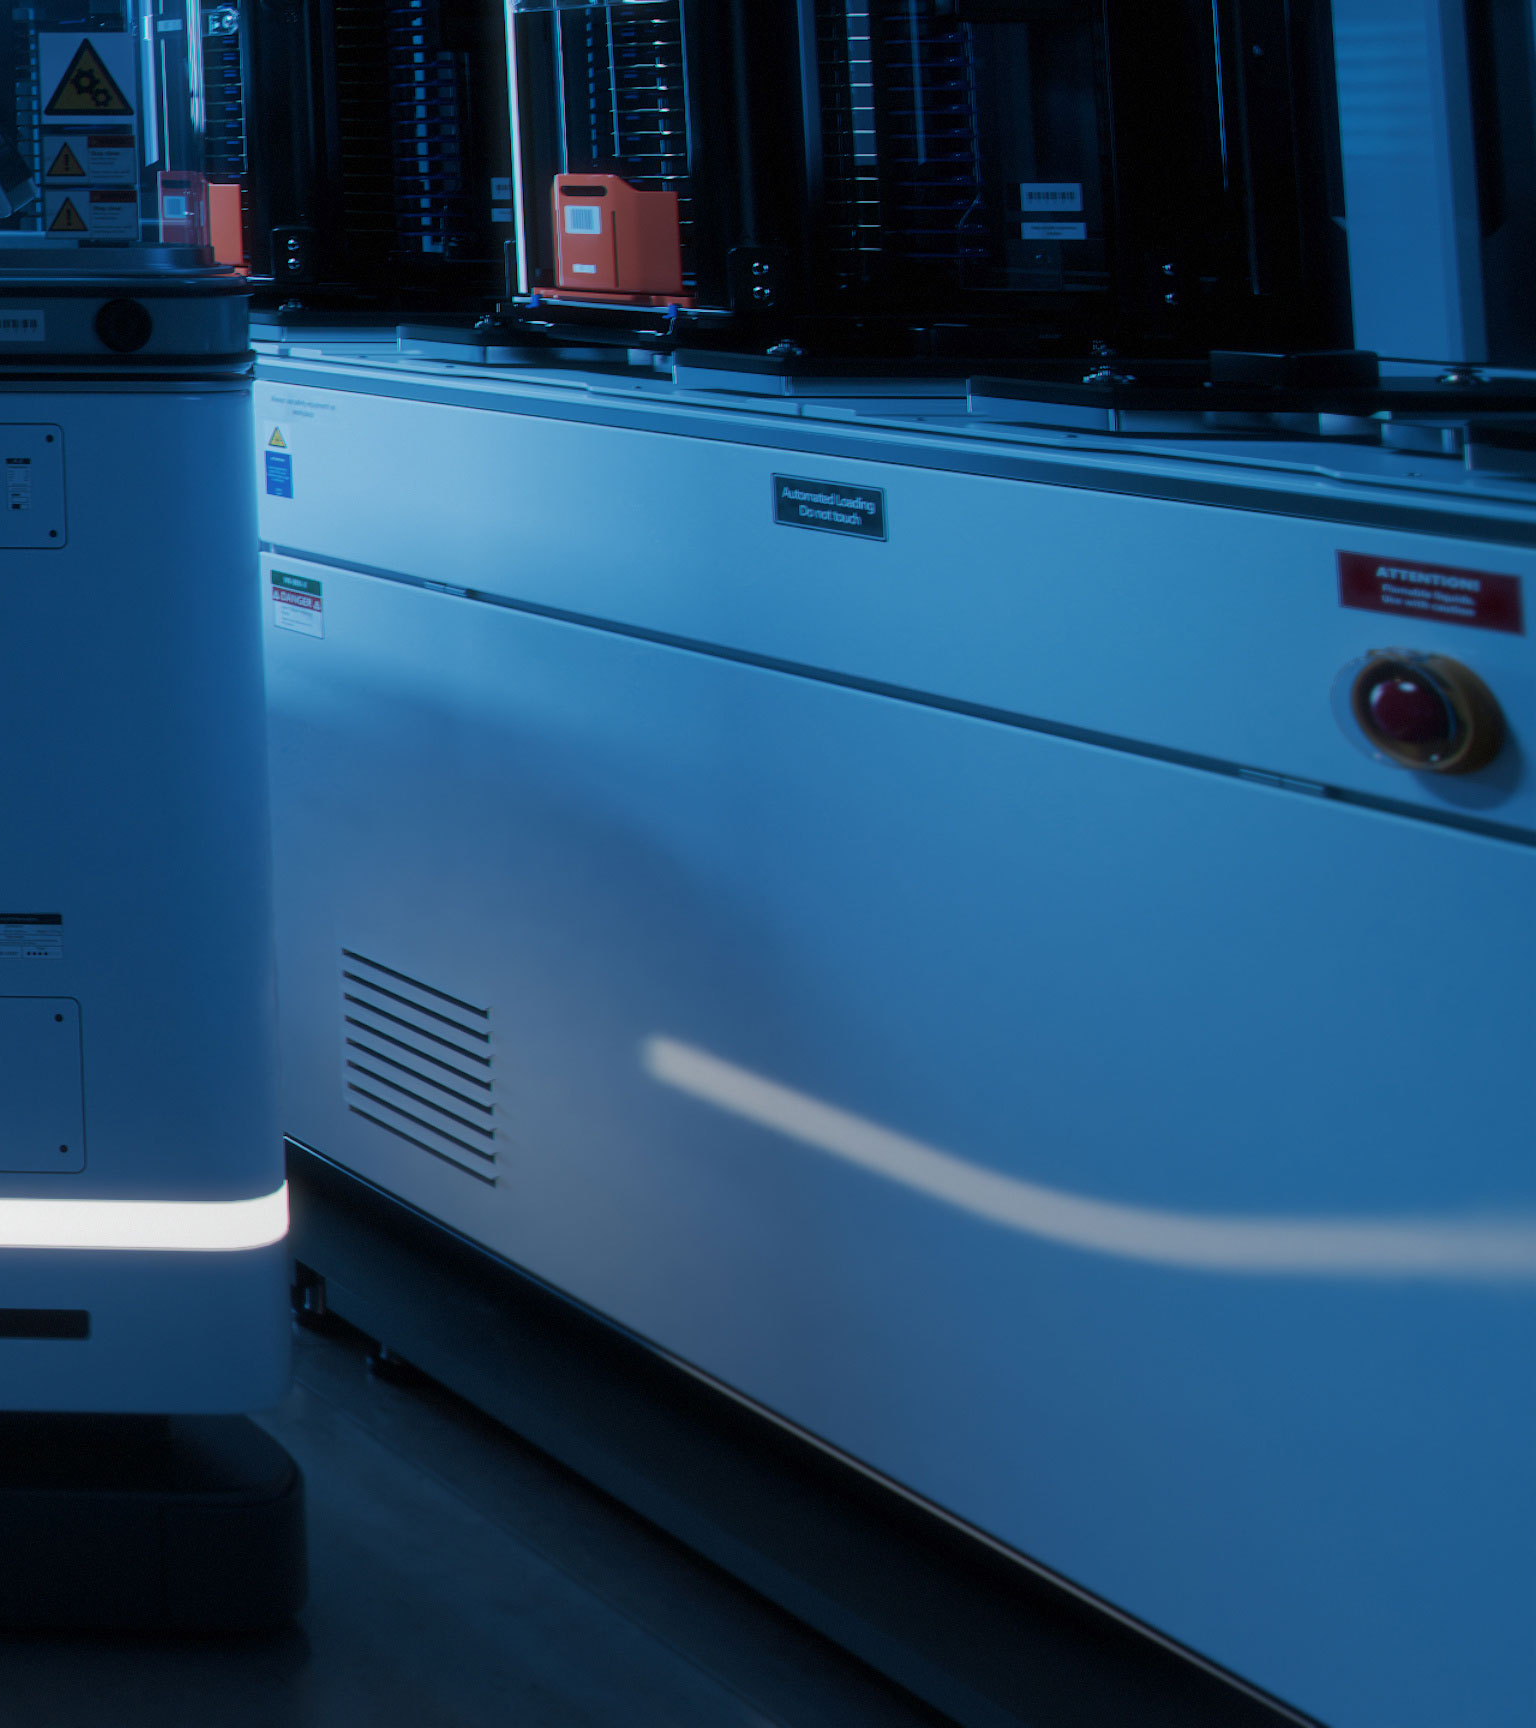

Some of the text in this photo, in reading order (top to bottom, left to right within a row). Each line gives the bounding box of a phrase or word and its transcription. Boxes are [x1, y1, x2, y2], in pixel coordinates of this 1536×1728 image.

[781, 486, 877, 515] Automated Loading
[798, 504, 863, 527] Do not touch
